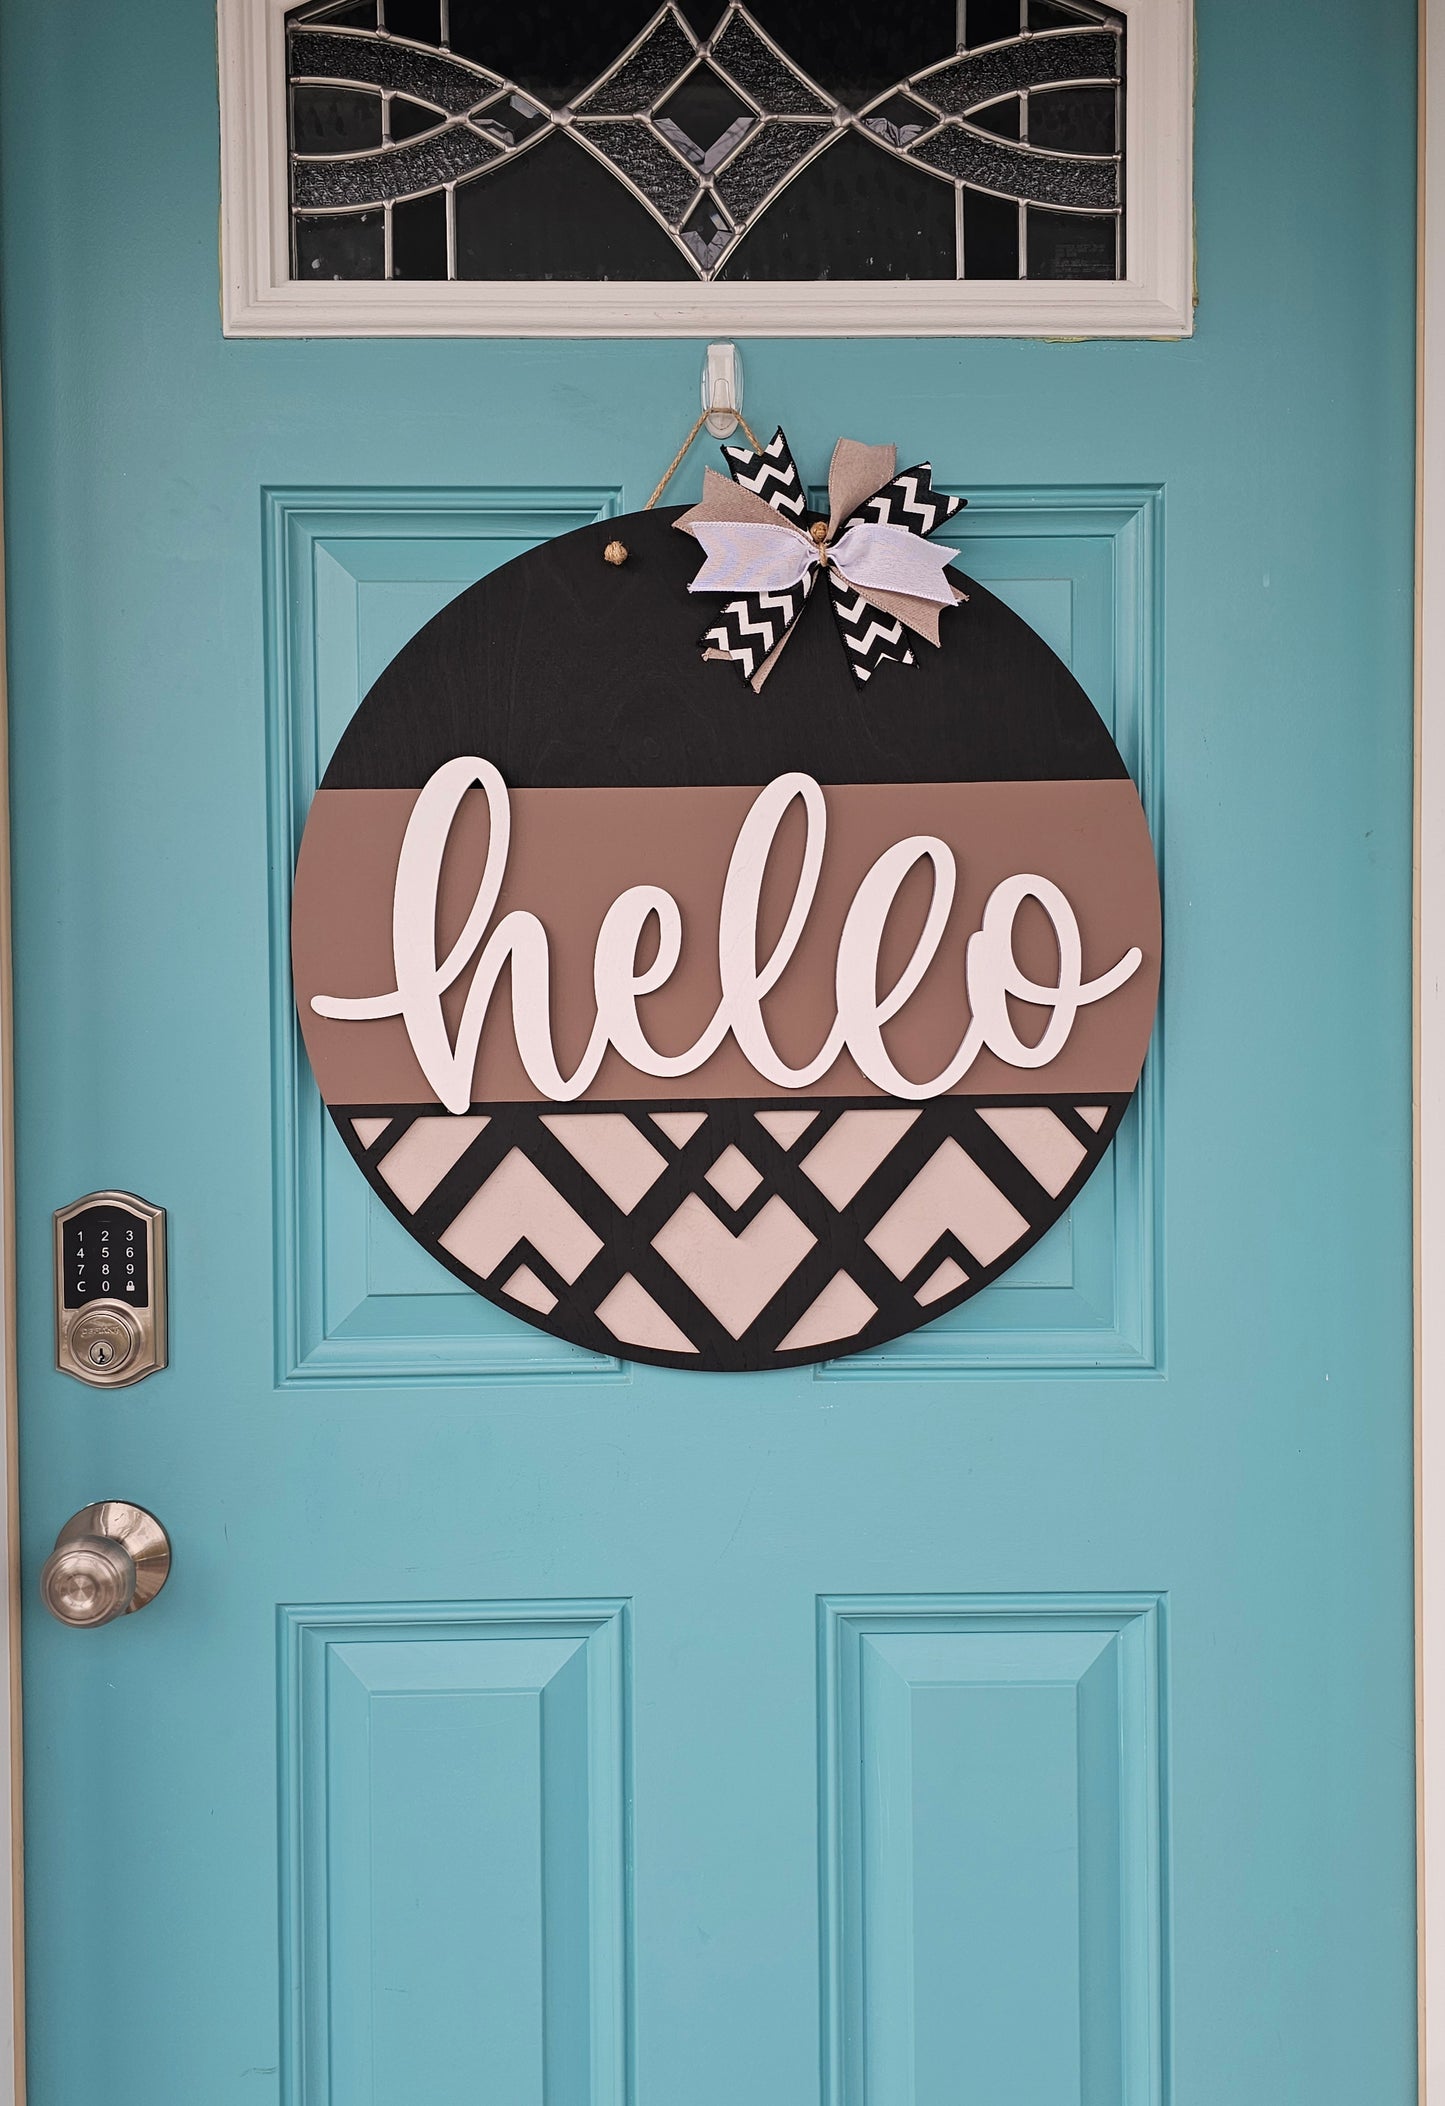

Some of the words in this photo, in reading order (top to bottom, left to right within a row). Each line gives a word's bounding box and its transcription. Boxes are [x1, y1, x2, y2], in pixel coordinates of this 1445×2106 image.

[312, 756, 1142, 1115] hello
[77, 1231, 83, 1242] 1
[101, 1230, 109, 1242] 2
[126, 1230, 134, 1242] 3
[76, 1247, 85, 1258] 4
[101, 1246, 109, 1258] 5
[126, 1246, 134, 1258] 6
[77, 1264, 85, 1275] 7
[101, 1264, 110, 1275] 8
[126, 1264, 135, 1275] 9
[77, 1281, 86, 1292] C
[102, 1280, 110, 1292] 0
